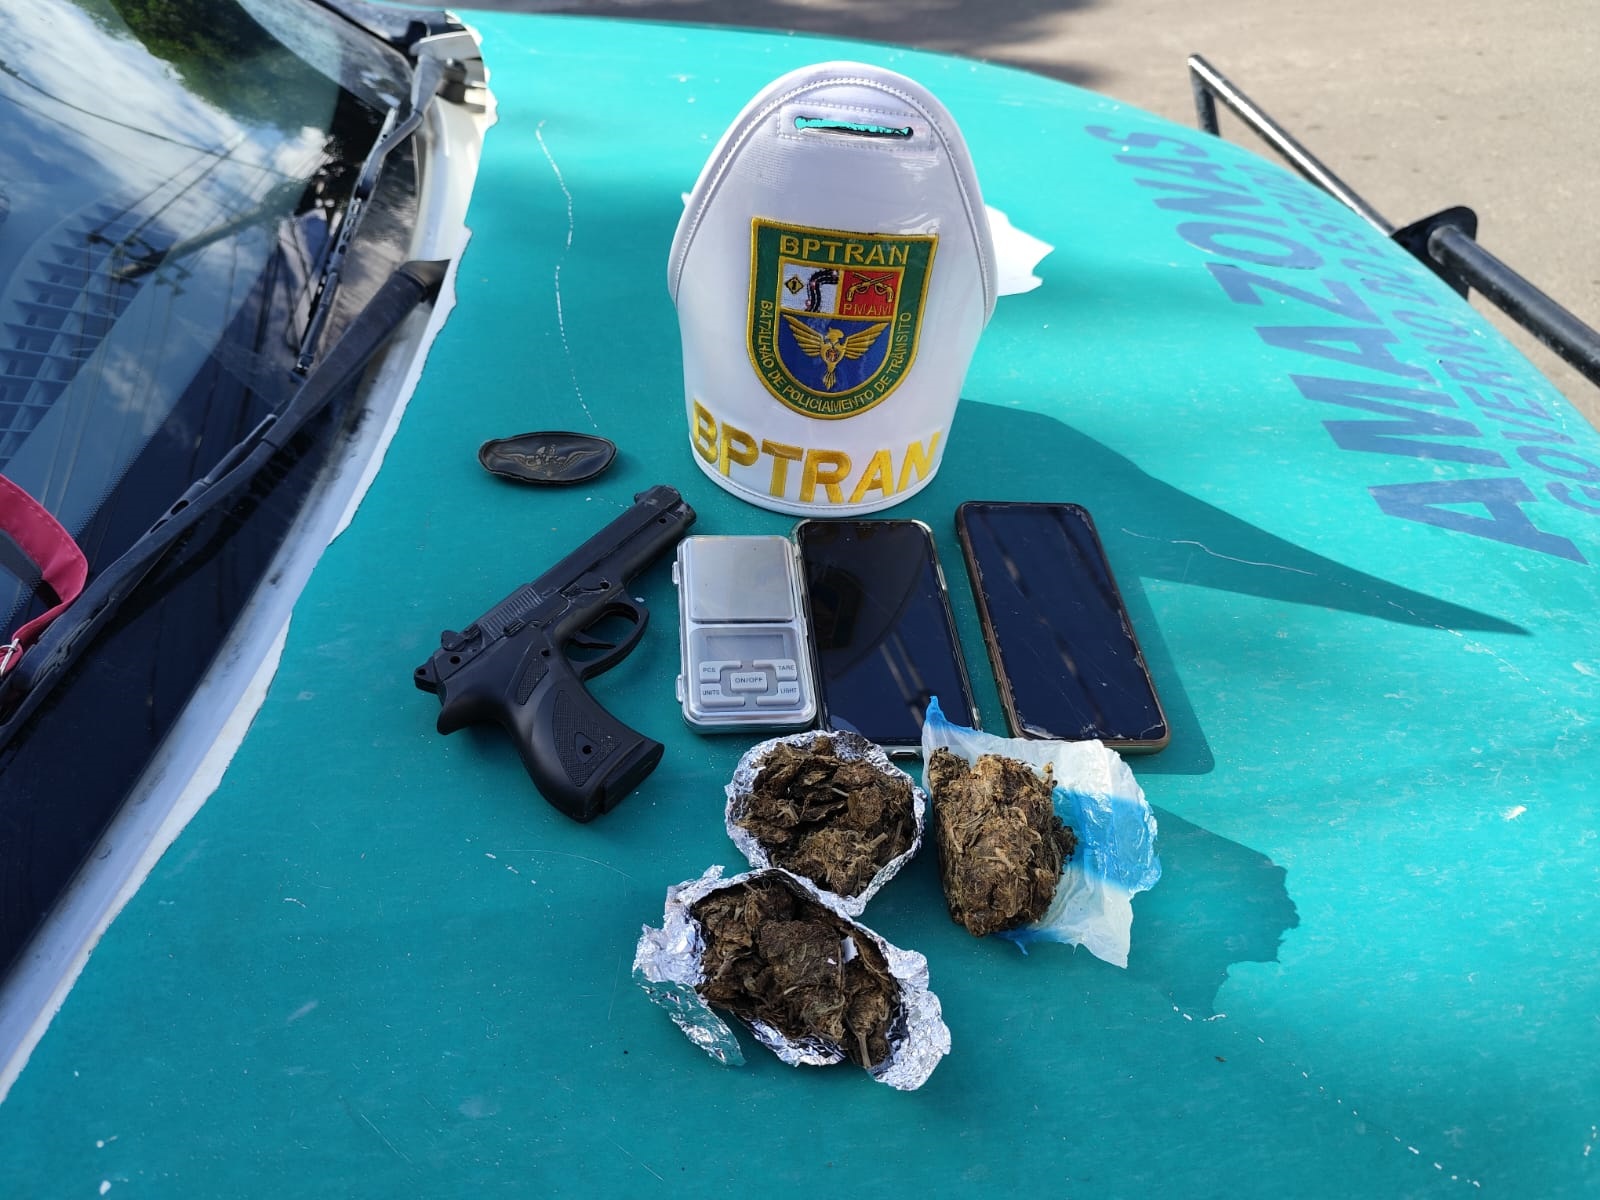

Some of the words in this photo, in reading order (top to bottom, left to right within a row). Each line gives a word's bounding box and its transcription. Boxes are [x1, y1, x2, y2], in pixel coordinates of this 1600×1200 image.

[780, 235, 909, 265] BPTRAN
[843, 303, 892, 316] PMAM
[1085, 125, 1589, 565] AMAZONAS
[768, 370, 786, 388] DE
[784, 386, 874, 413] POLICIAMENTO
[874, 375, 892, 393] DE
[693, 398, 942, 504] BPTRAN
